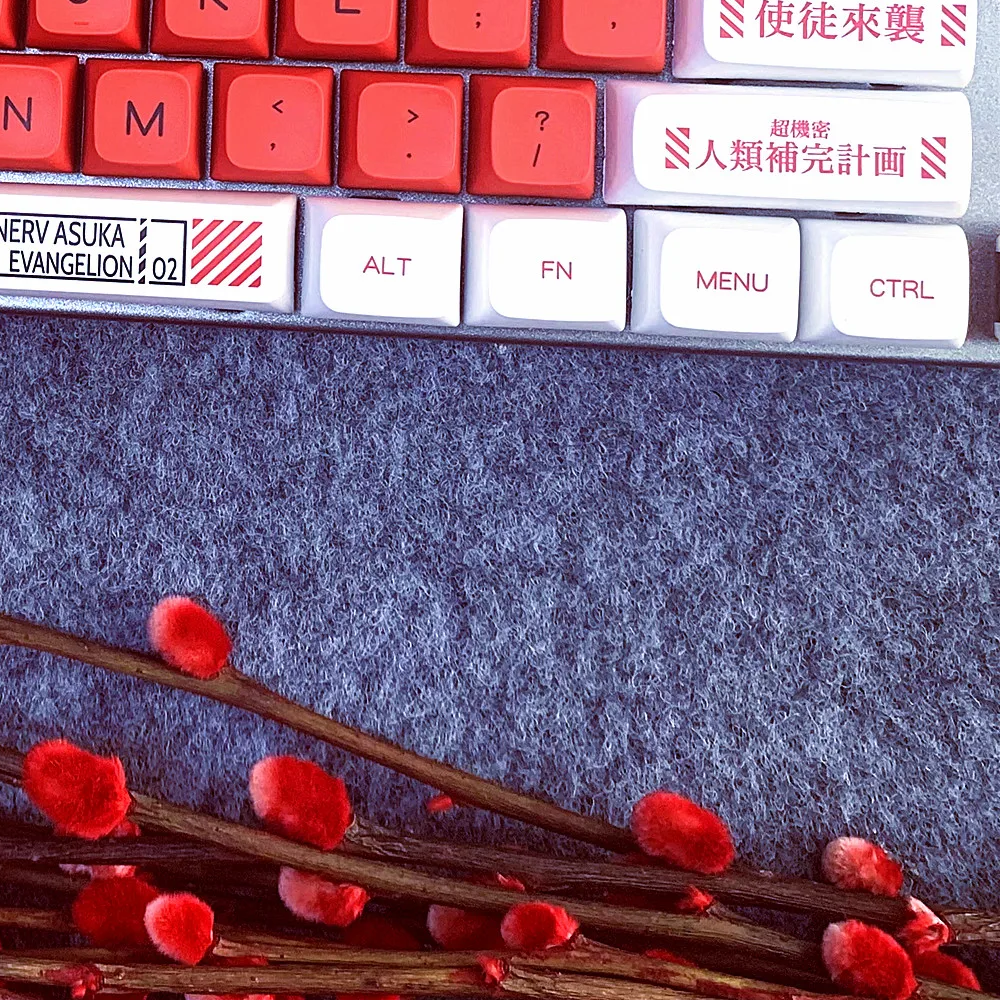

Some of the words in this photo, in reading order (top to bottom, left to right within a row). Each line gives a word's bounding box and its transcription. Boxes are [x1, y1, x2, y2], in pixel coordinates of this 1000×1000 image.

[2, 95, 33, 132] N
[125, 100, 165, 138] M
[53, 220, 126, 249] ASUKA
[9, 250, 133, 279] EVANGELION
[152, 257, 178, 281] 02
[362, 255, 412, 277] ALT
[541, 260, 573, 281] FN
[696, 270, 769, 293] MENU
[869, 278, 935, 300] CTRL
